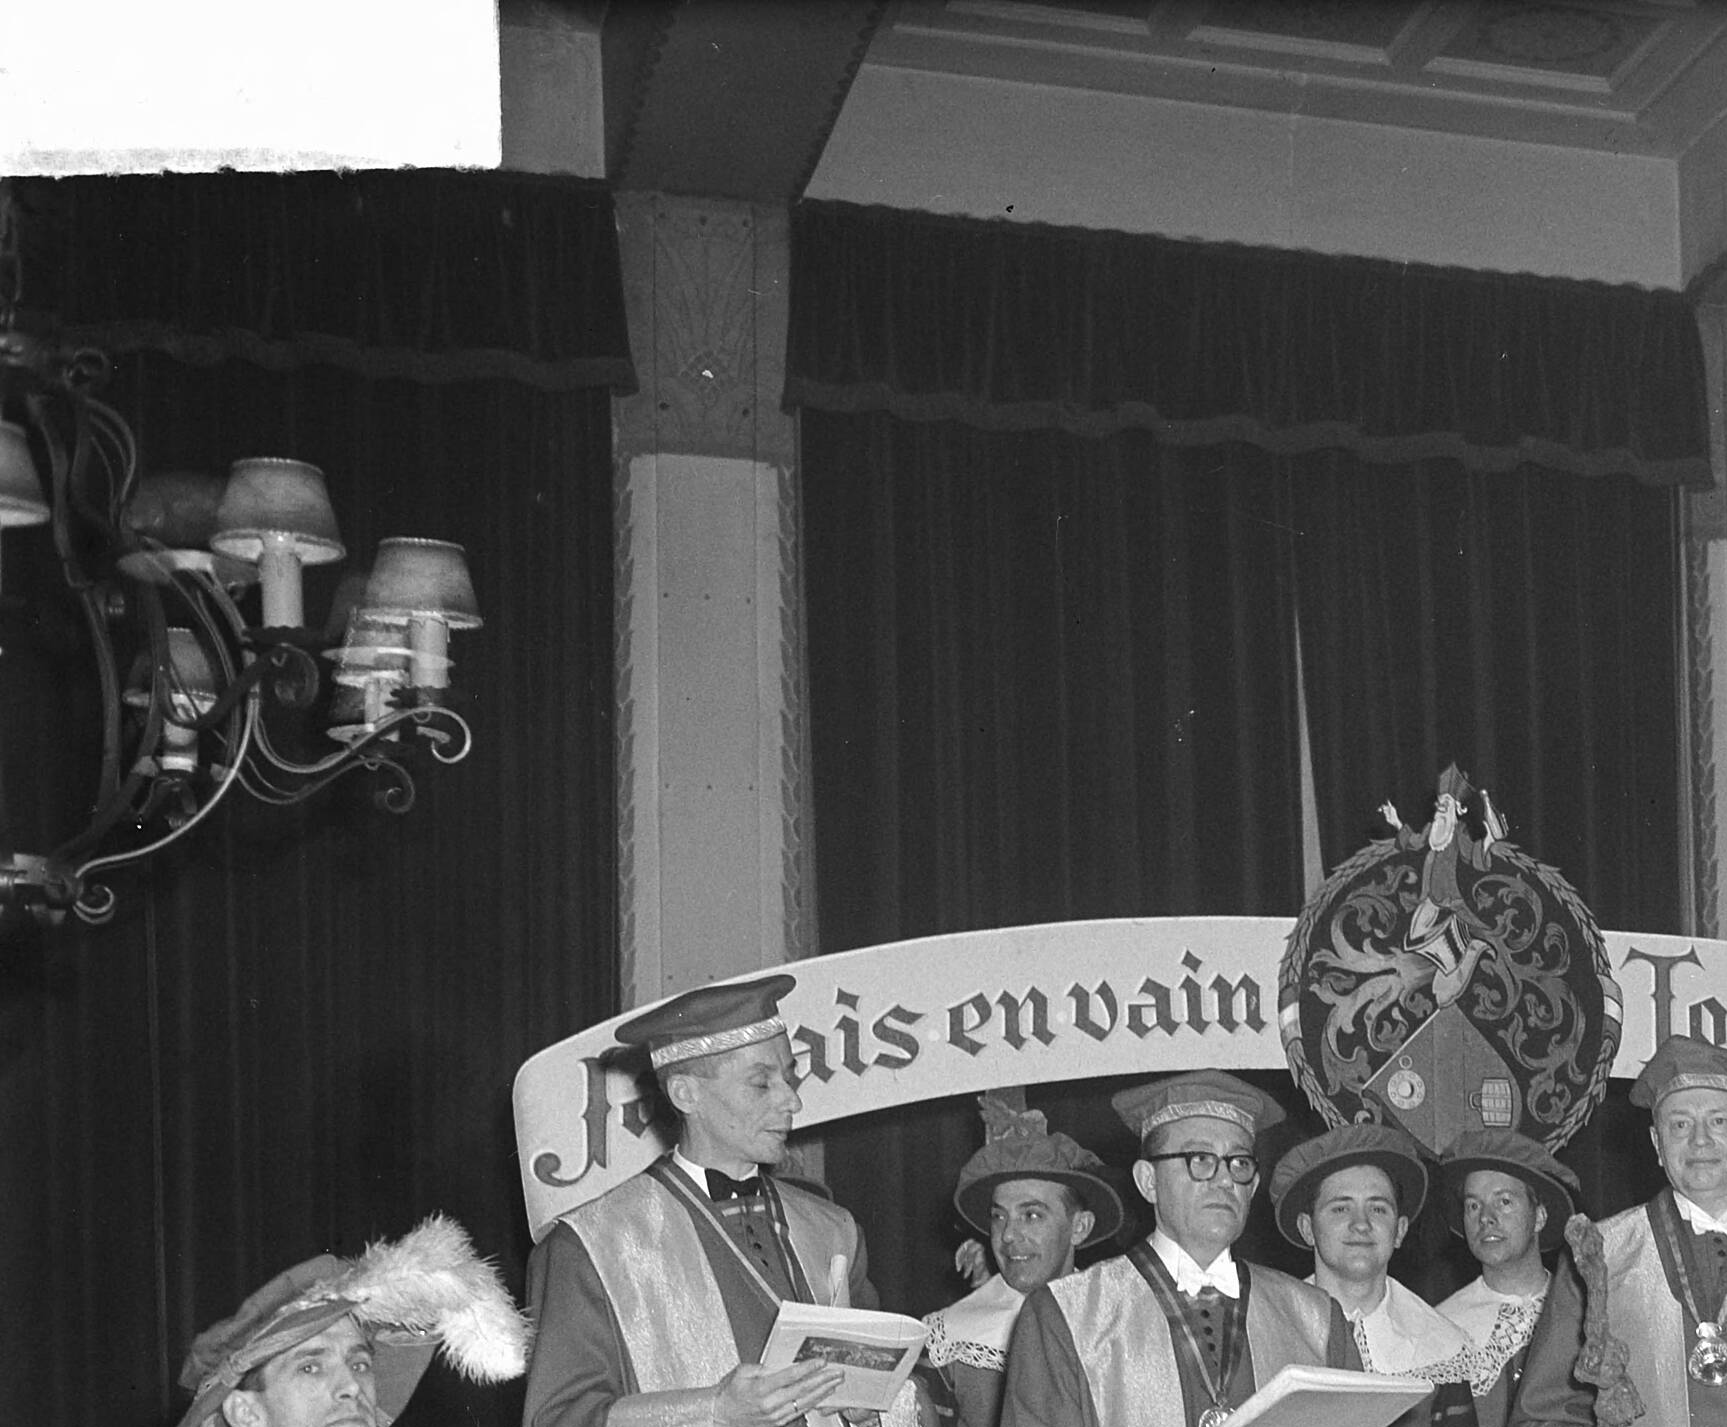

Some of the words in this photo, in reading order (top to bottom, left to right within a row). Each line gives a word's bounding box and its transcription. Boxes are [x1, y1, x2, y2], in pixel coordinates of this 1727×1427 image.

[533, 987, 924, 1188] Jais
[947, 985, 1058, 1058] en
[1066, 949, 1268, 1043] vain
